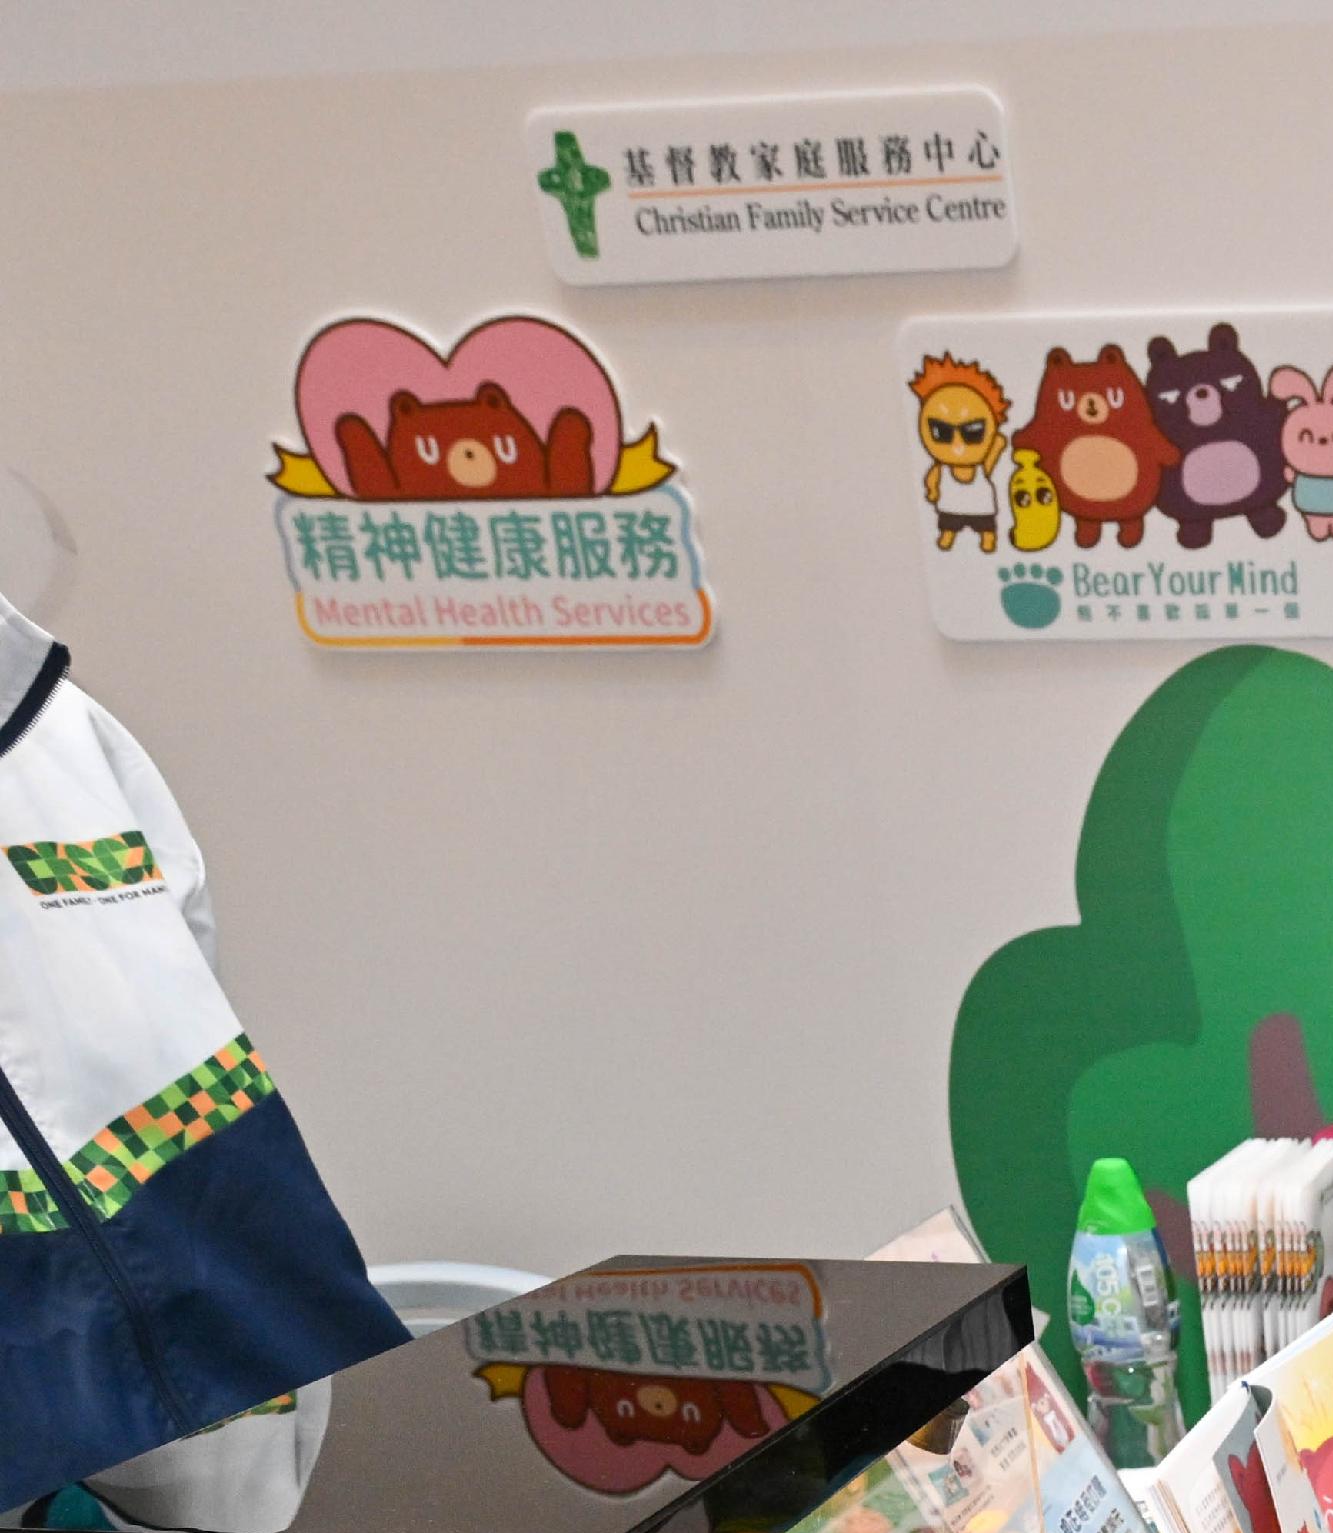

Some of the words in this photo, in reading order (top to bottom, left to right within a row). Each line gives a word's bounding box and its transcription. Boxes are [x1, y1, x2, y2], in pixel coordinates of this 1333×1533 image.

[625, 131, 999, 187] 基督教家庭服務中心
[636, 206, 741, 236] Christian
[749, 202, 825, 233] Family
[832, 198, 919, 228] Service
[926, 196, 1006, 222] Centre
[294, 511, 679, 581] 精神健康服務
[1073, 563, 1142, 597] Bear
[1149, 563, 1220, 597] Your
[1230, 561, 1299, 595] Mind
[315, 597, 427, 626] Mental
[437, 597, 543, 627] Health
[556, 596, 692, 627] Services
